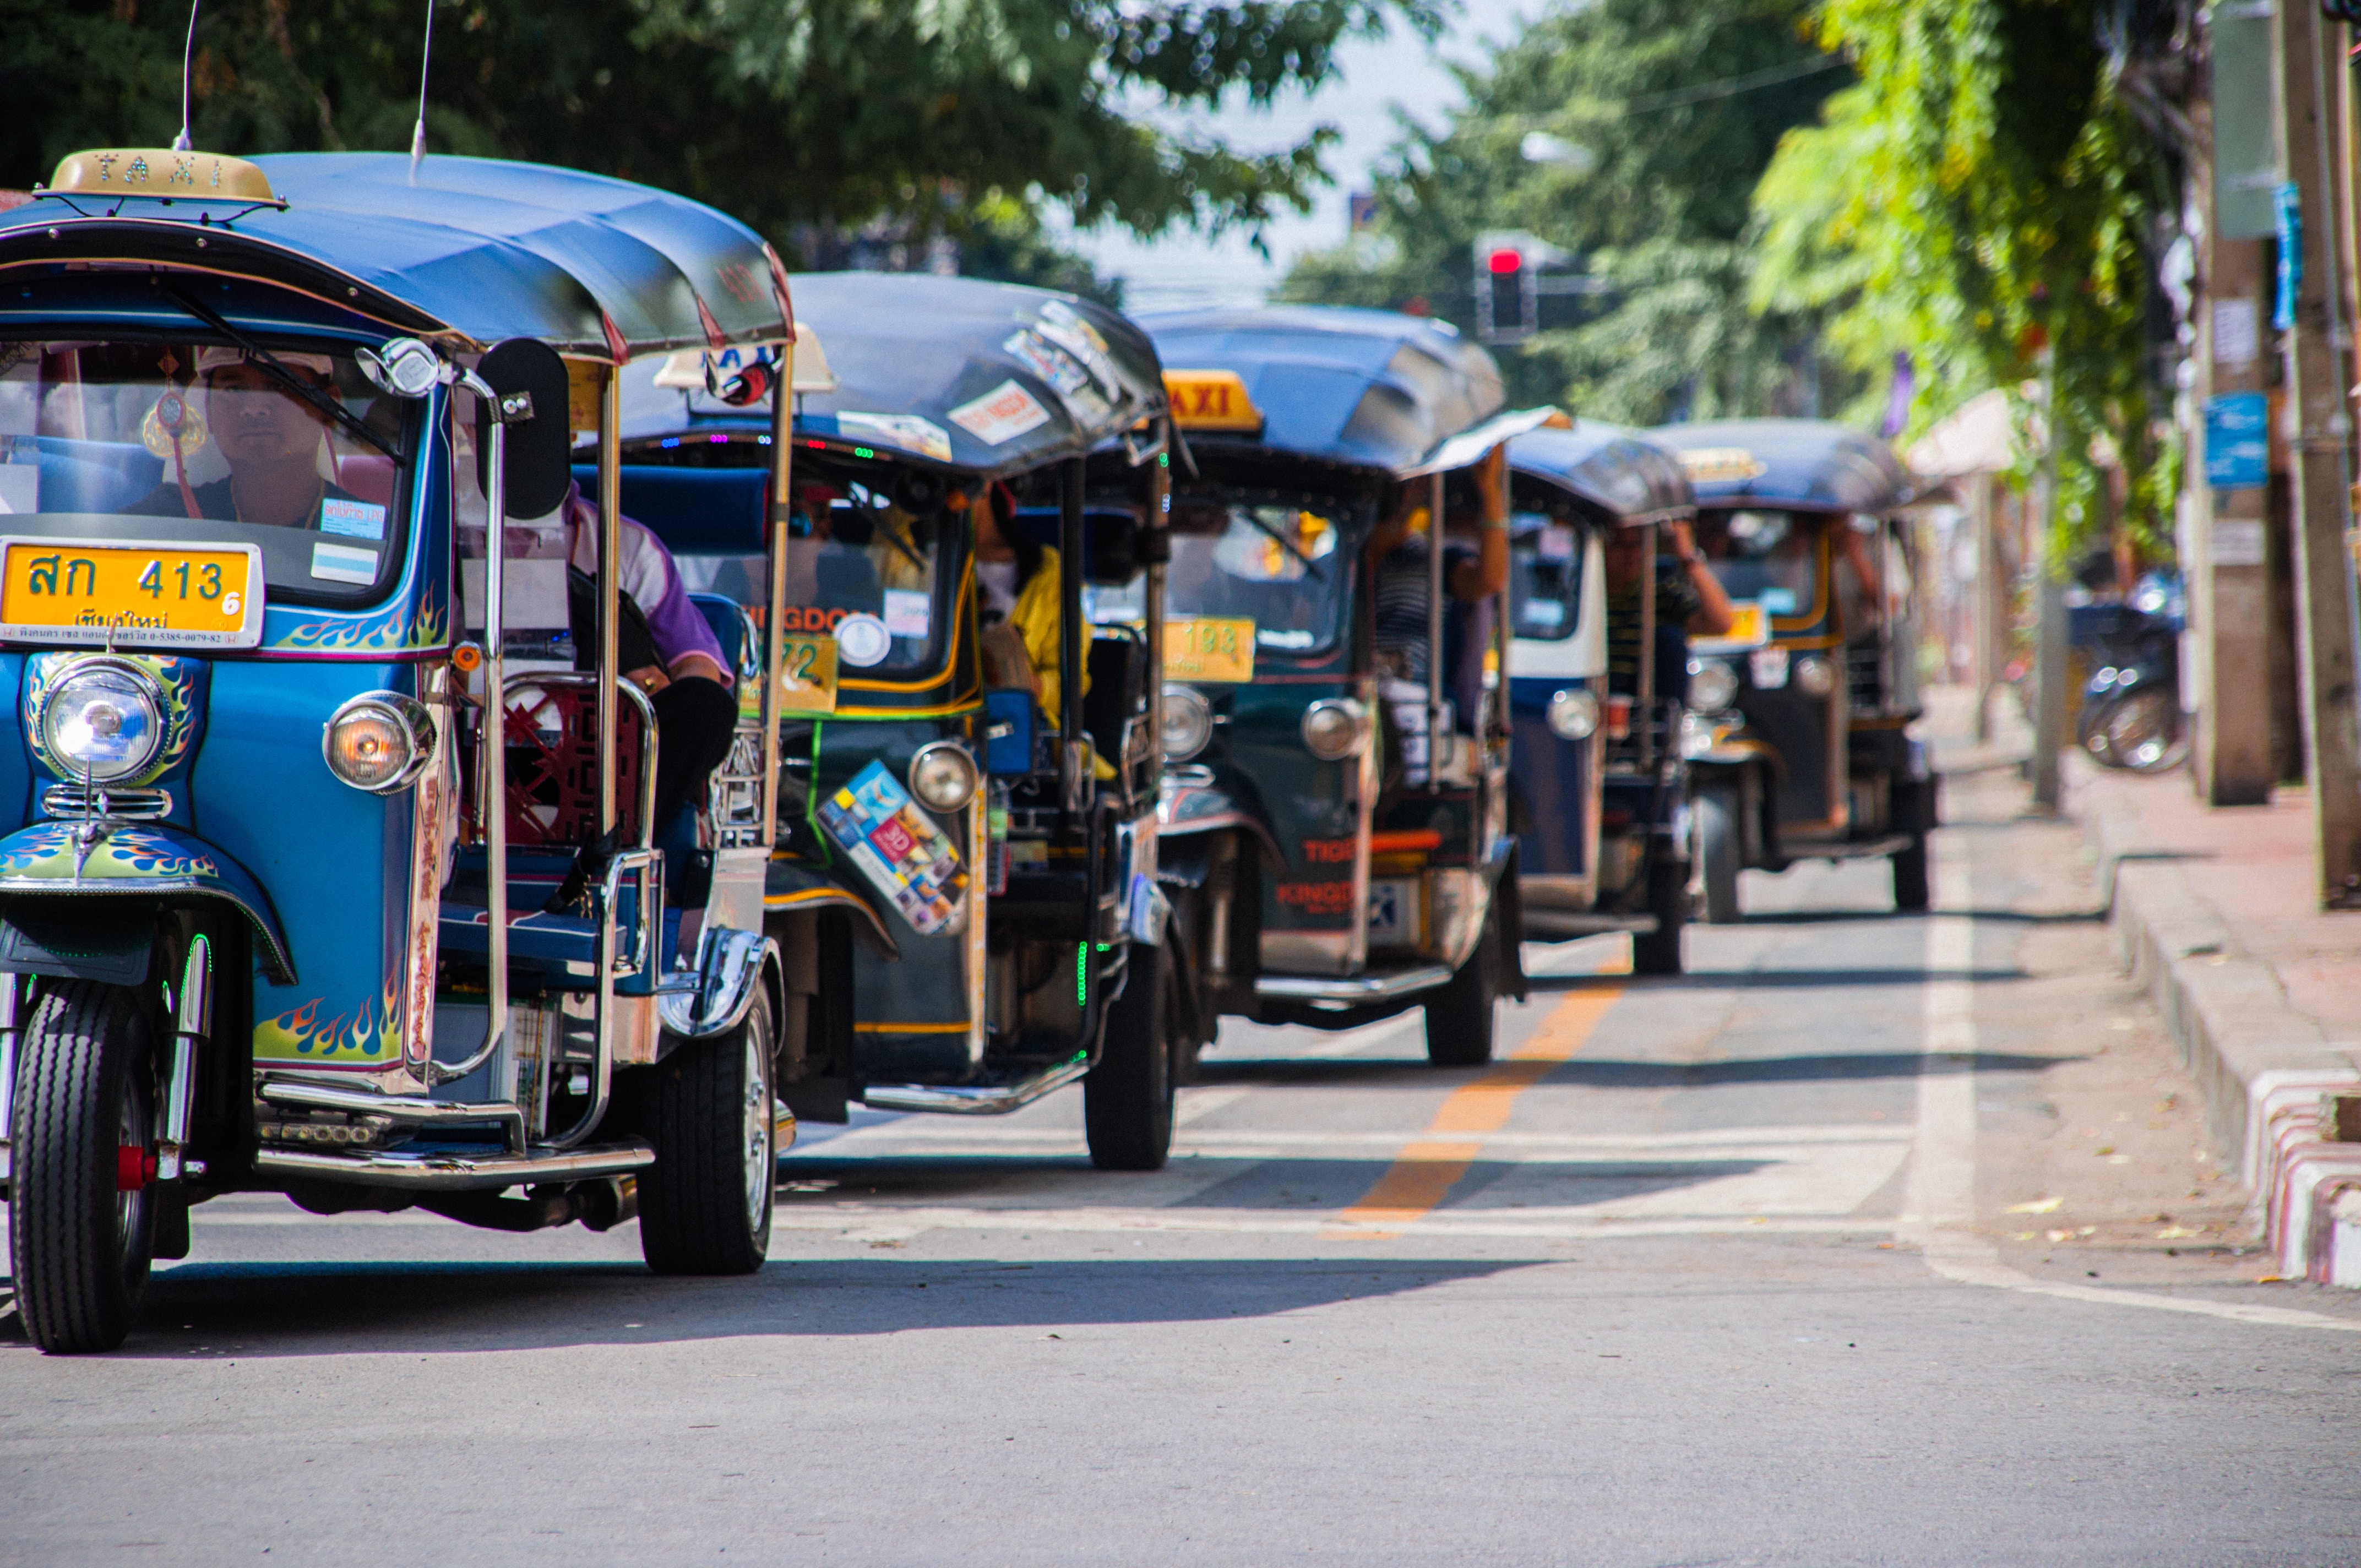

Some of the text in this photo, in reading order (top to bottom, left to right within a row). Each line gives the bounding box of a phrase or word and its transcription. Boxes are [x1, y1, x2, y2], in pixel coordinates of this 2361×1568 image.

[94, 152, 221, 187] TAXI
[1169, 385, 1230, 415] AXI
[368, 509, 384, 522] LPG
[29, 554, 222, 599] สก 413
[222, 591, 241, 615] 6
[150, 633, 221, 643] 0-5385-0079-82
